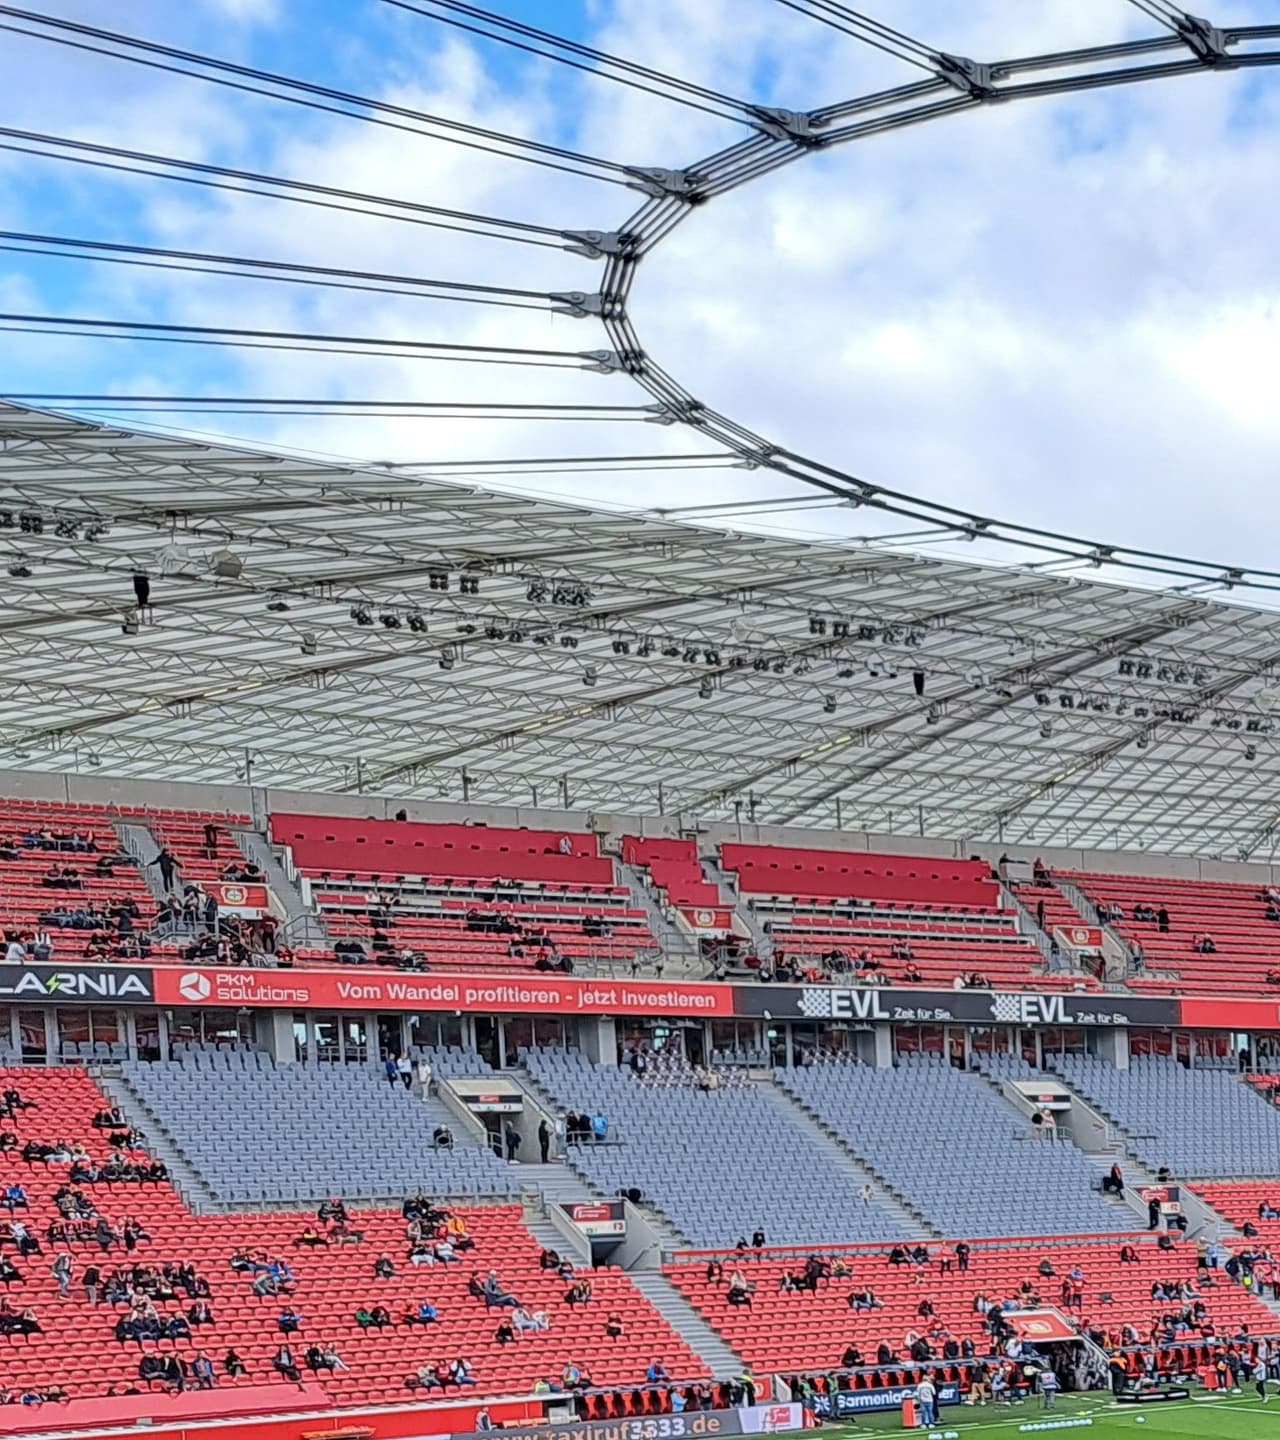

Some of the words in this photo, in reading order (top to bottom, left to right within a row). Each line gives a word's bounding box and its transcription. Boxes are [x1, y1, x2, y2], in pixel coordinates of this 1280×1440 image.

[216, 974, 255, 986] PKM
[216, 986, 309, 1002] solutions
[337, 982, 381, 999] Vom
[386, 982, 460, 1001] Wandel
[464, 986, 560, 1007] profitieren
[831, 991, 890, 1018] EVL
[1020, 996, 1074, 1023] EVL
